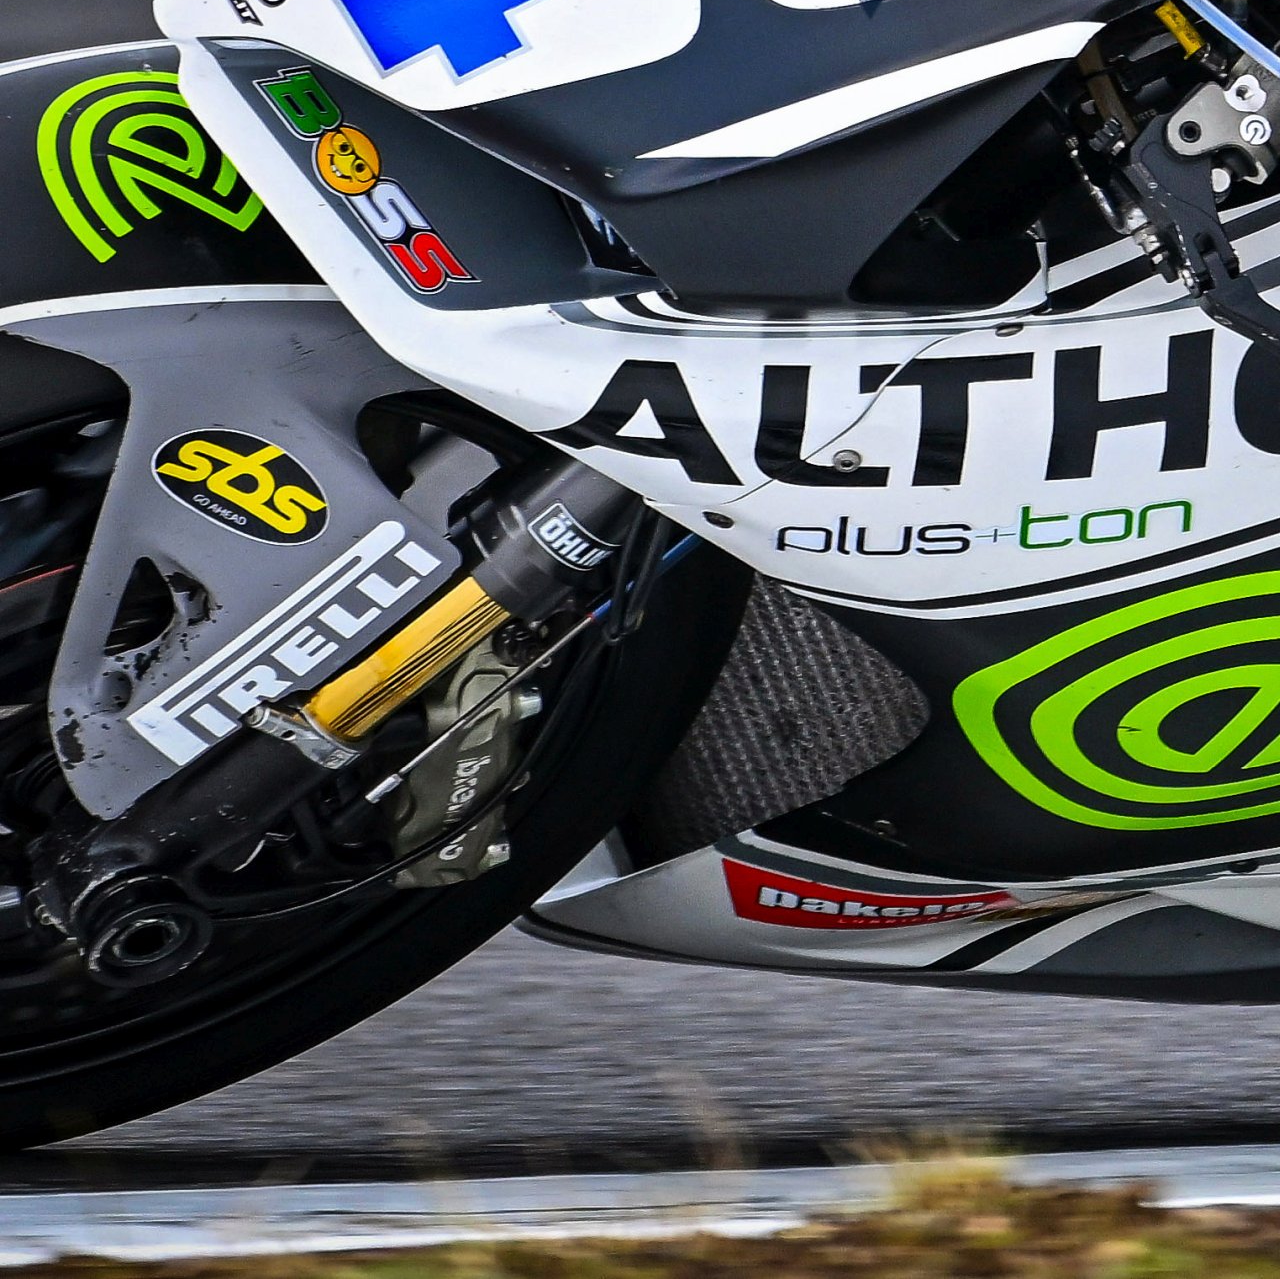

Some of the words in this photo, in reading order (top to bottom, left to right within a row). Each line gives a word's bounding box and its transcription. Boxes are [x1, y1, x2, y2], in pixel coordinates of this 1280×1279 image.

[156, 439, 328, 535] sbs
[127, 520, 442, 767] PIRELLI
[758, 886, 986, 918] pakelo
